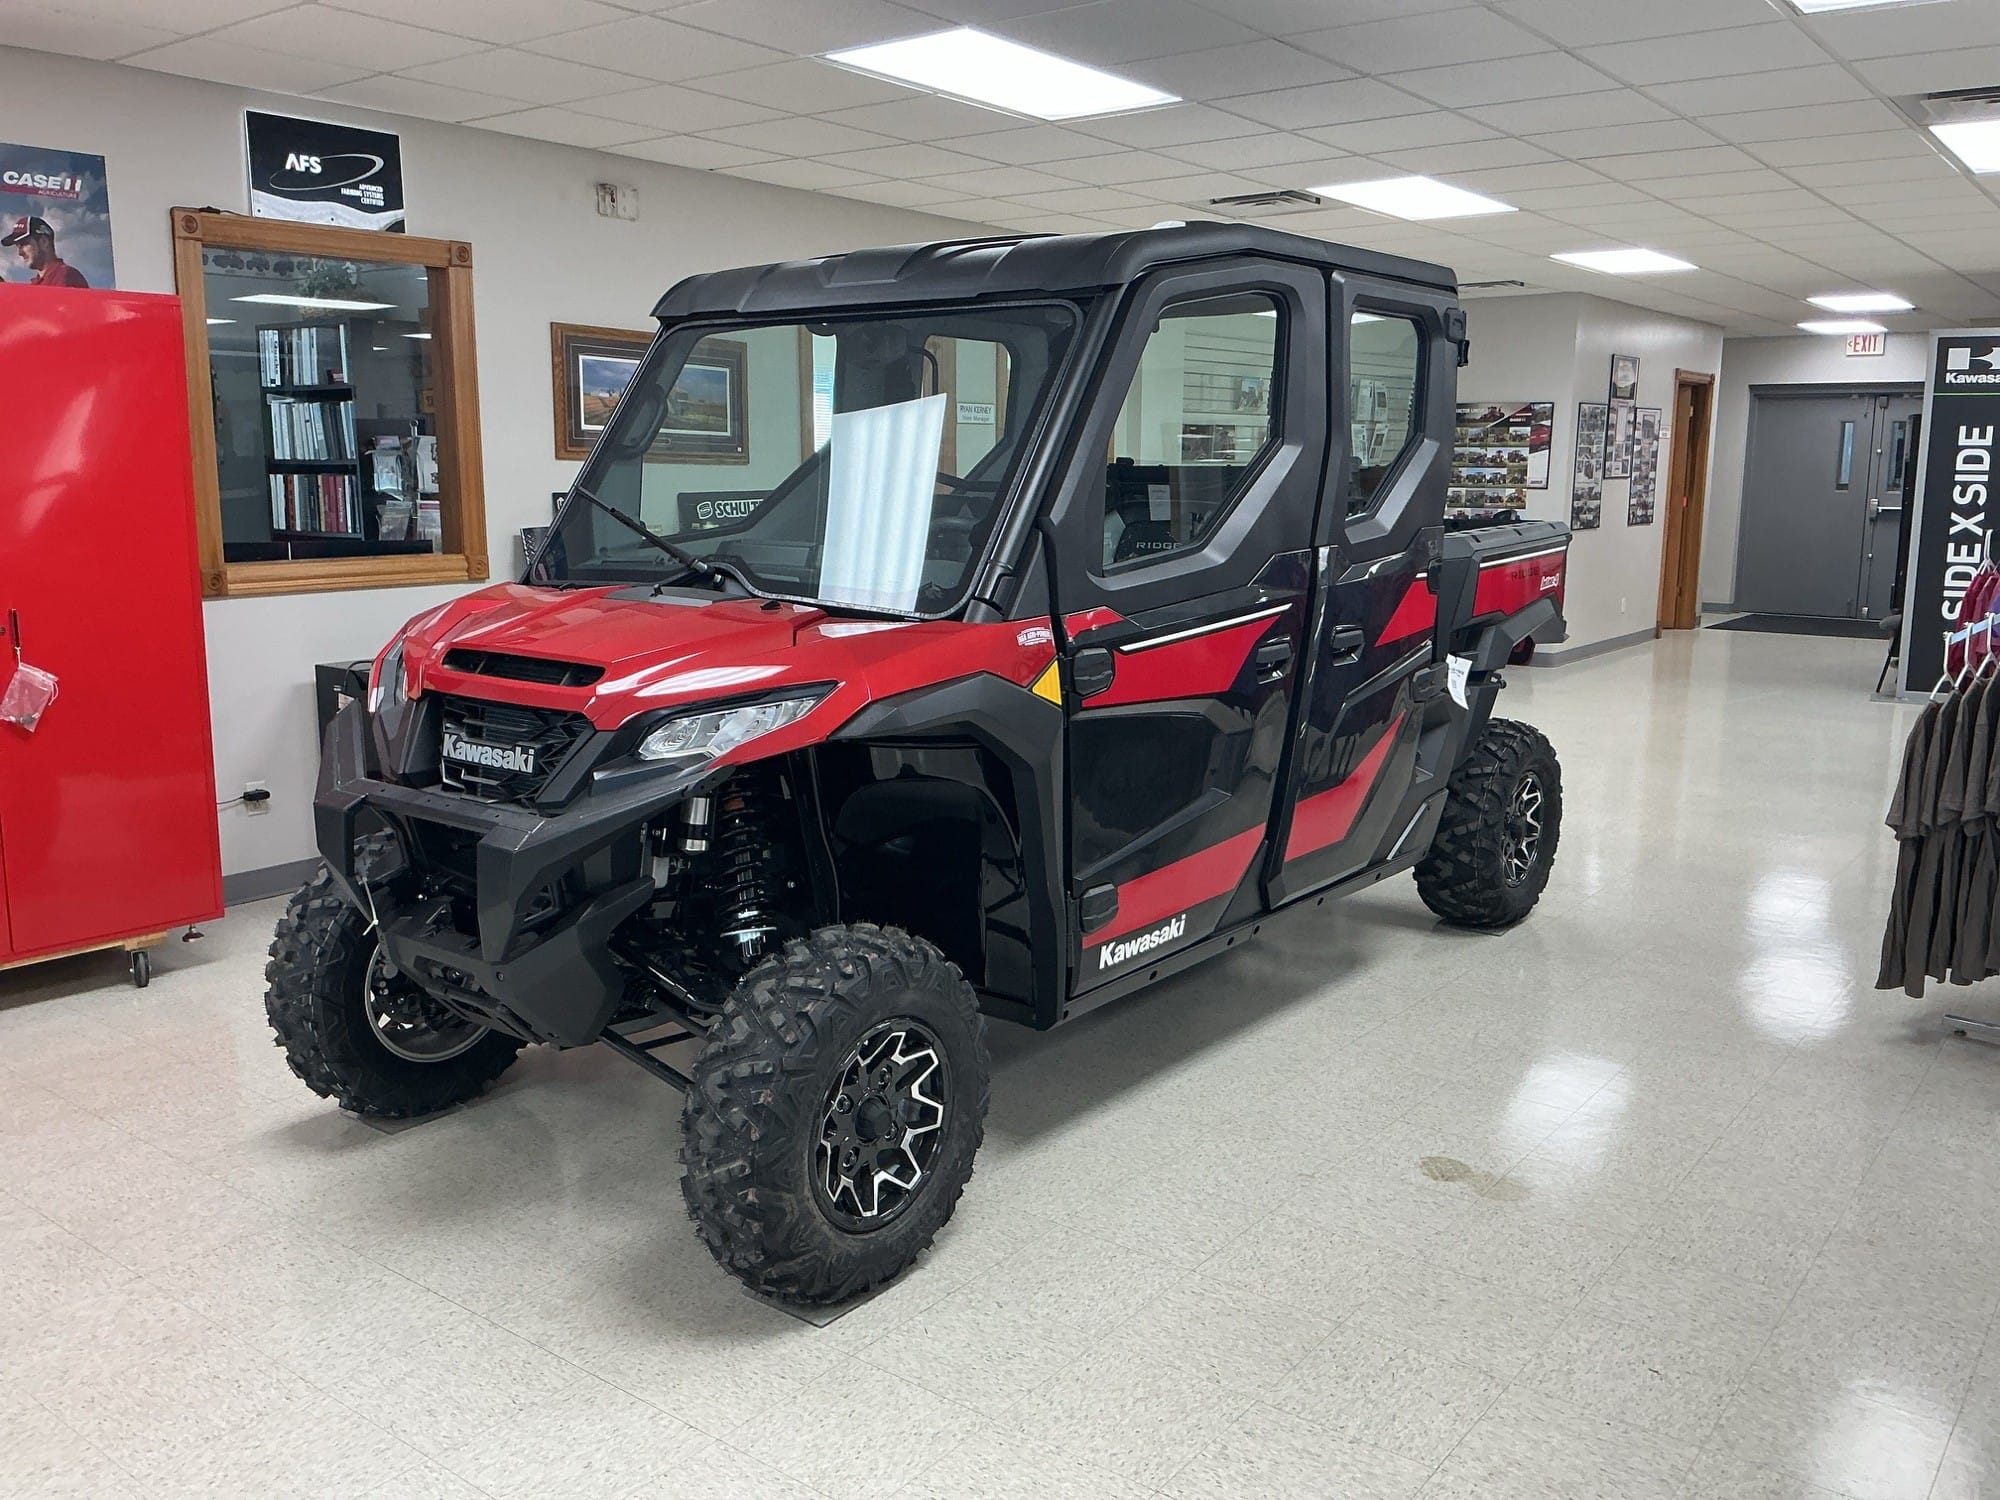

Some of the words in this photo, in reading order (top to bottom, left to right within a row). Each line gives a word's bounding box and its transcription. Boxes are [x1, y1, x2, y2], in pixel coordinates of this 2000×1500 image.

[285, 153, 322, 174] AFS
[3, 171, 62, 189] CASE
[1853, 335, 1879, 352] EXIT
[1952, 425, 1994, 507] SIDE
[1949, 511, 1985, 536] X
[442, 733, 535, 773] Kawasaki
[1099, 914, 1186, 969] Kawasaki
